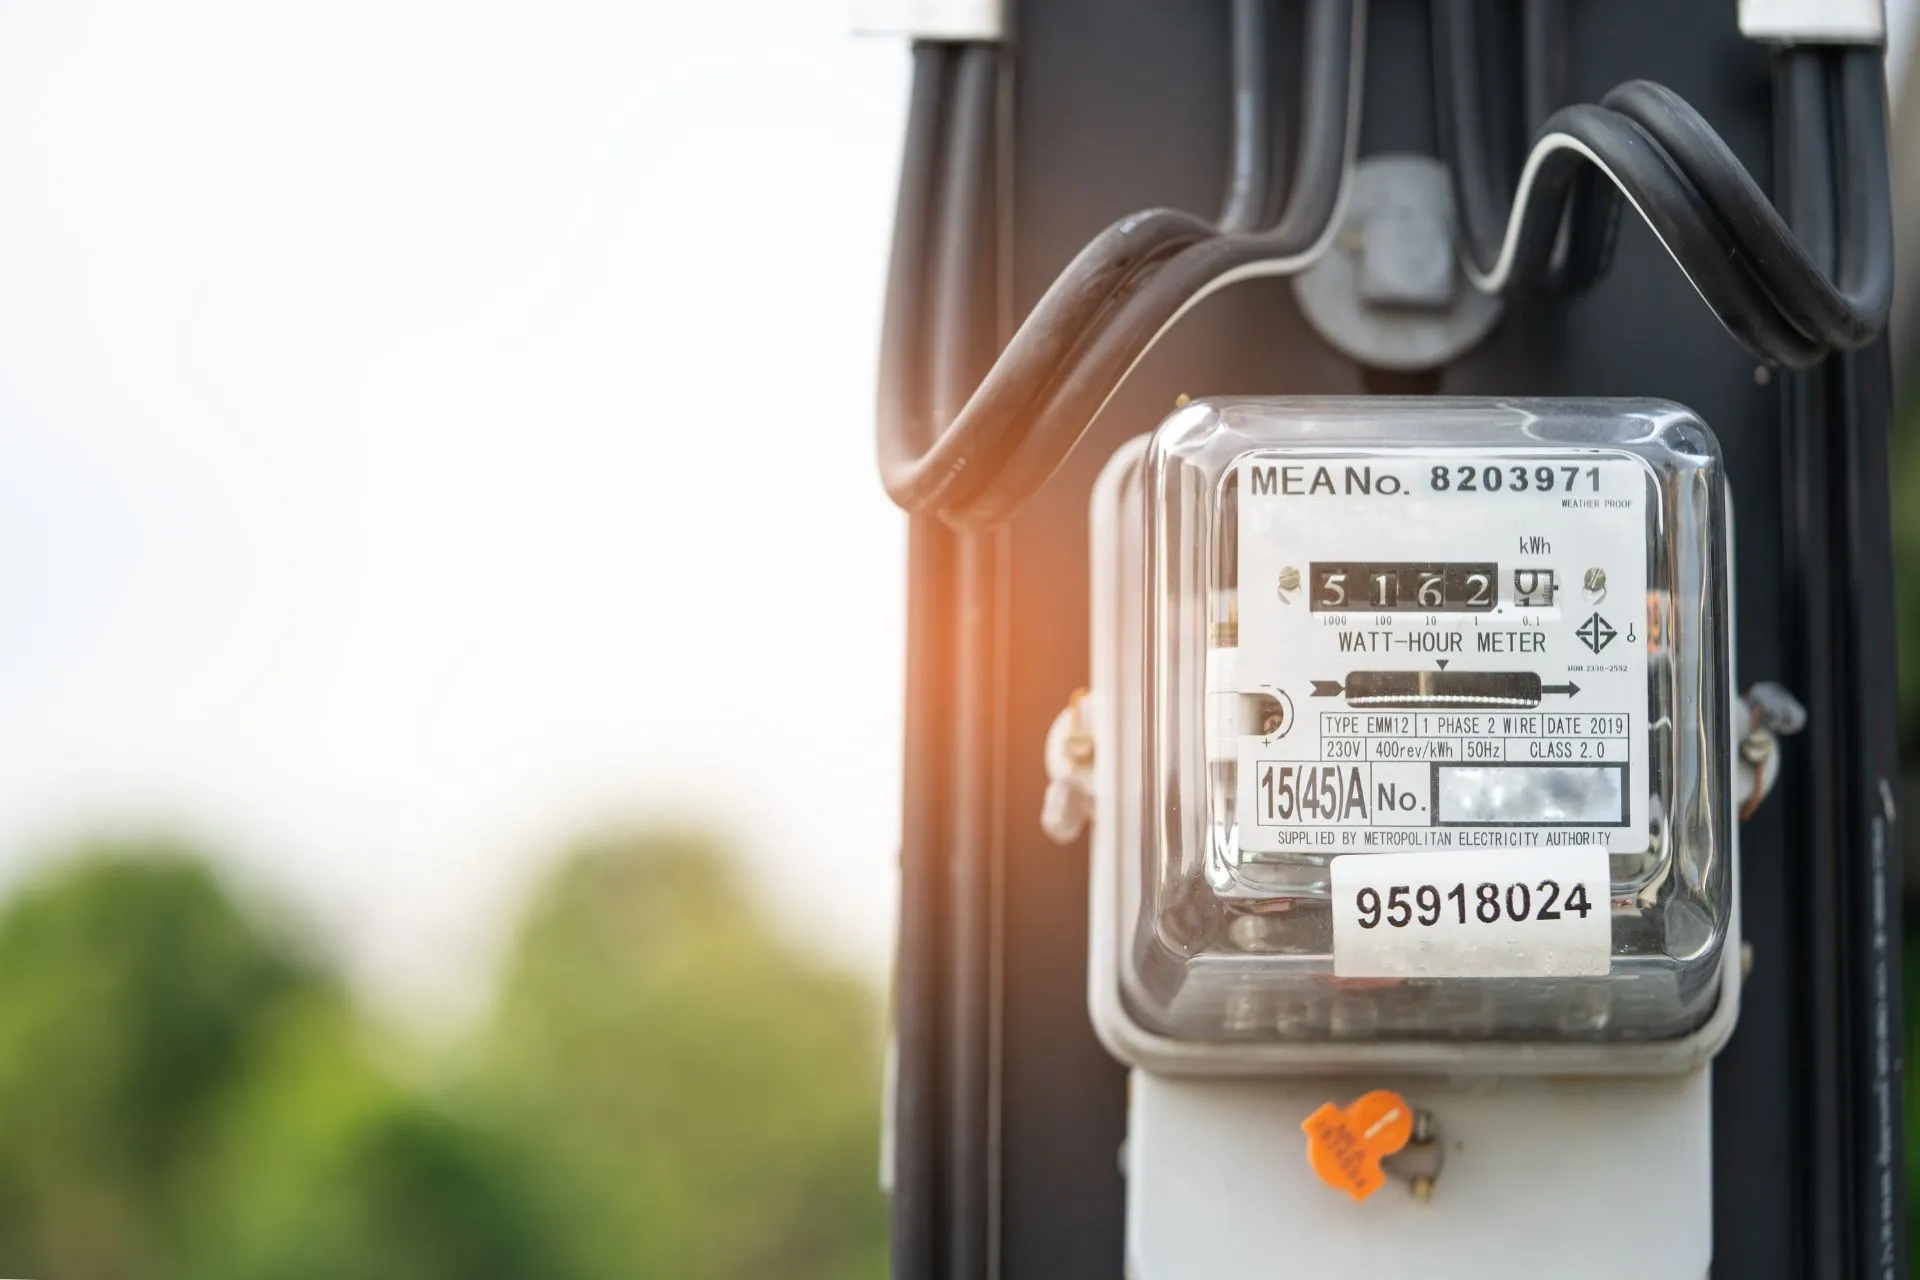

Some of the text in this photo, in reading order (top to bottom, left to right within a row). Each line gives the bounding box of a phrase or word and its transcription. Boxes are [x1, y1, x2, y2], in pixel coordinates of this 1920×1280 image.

[1251, 465, 1600, 495] MEA No. 8203971
[1561, 499, 1632, 508] WEATHER PROOF
[1519, 536, 1551, 555] kWh
[1322, 615, 1347, 626] 1000
[1375, 615, 1392, 626] 100
[1425, 615, 1437, 626] 10
[1474, 615, 1479, 626] 1
[1522, 615, 1540, 626] 0.1
[1339, 631, 1546, 653] WATT-HOUR METER
[1326, 716, 1409, 734] TYPE EMM12
[1424, 716, 1537, 734] 1 PHASE 2 WIRE
[1547, 716, 1623, 734] DATE 2019
[1327, 740, 1361, 758] 230V
[1375, 740, 1453, 758] 400rev/kWh
[1467, 741, 1500, 758] 50Hz
[1529, 741, 1605, 759] CLASS 2.0
[1262, 765, 1368, 822] 15(45)A
[1377, 783, 1427, 811] No.
[1278, 831, 1611, 846] SUPPLIED BY METROPOLITAN ELECTRICITY AUTHORITY
[1356, 879, 1592, 929] 95918024
